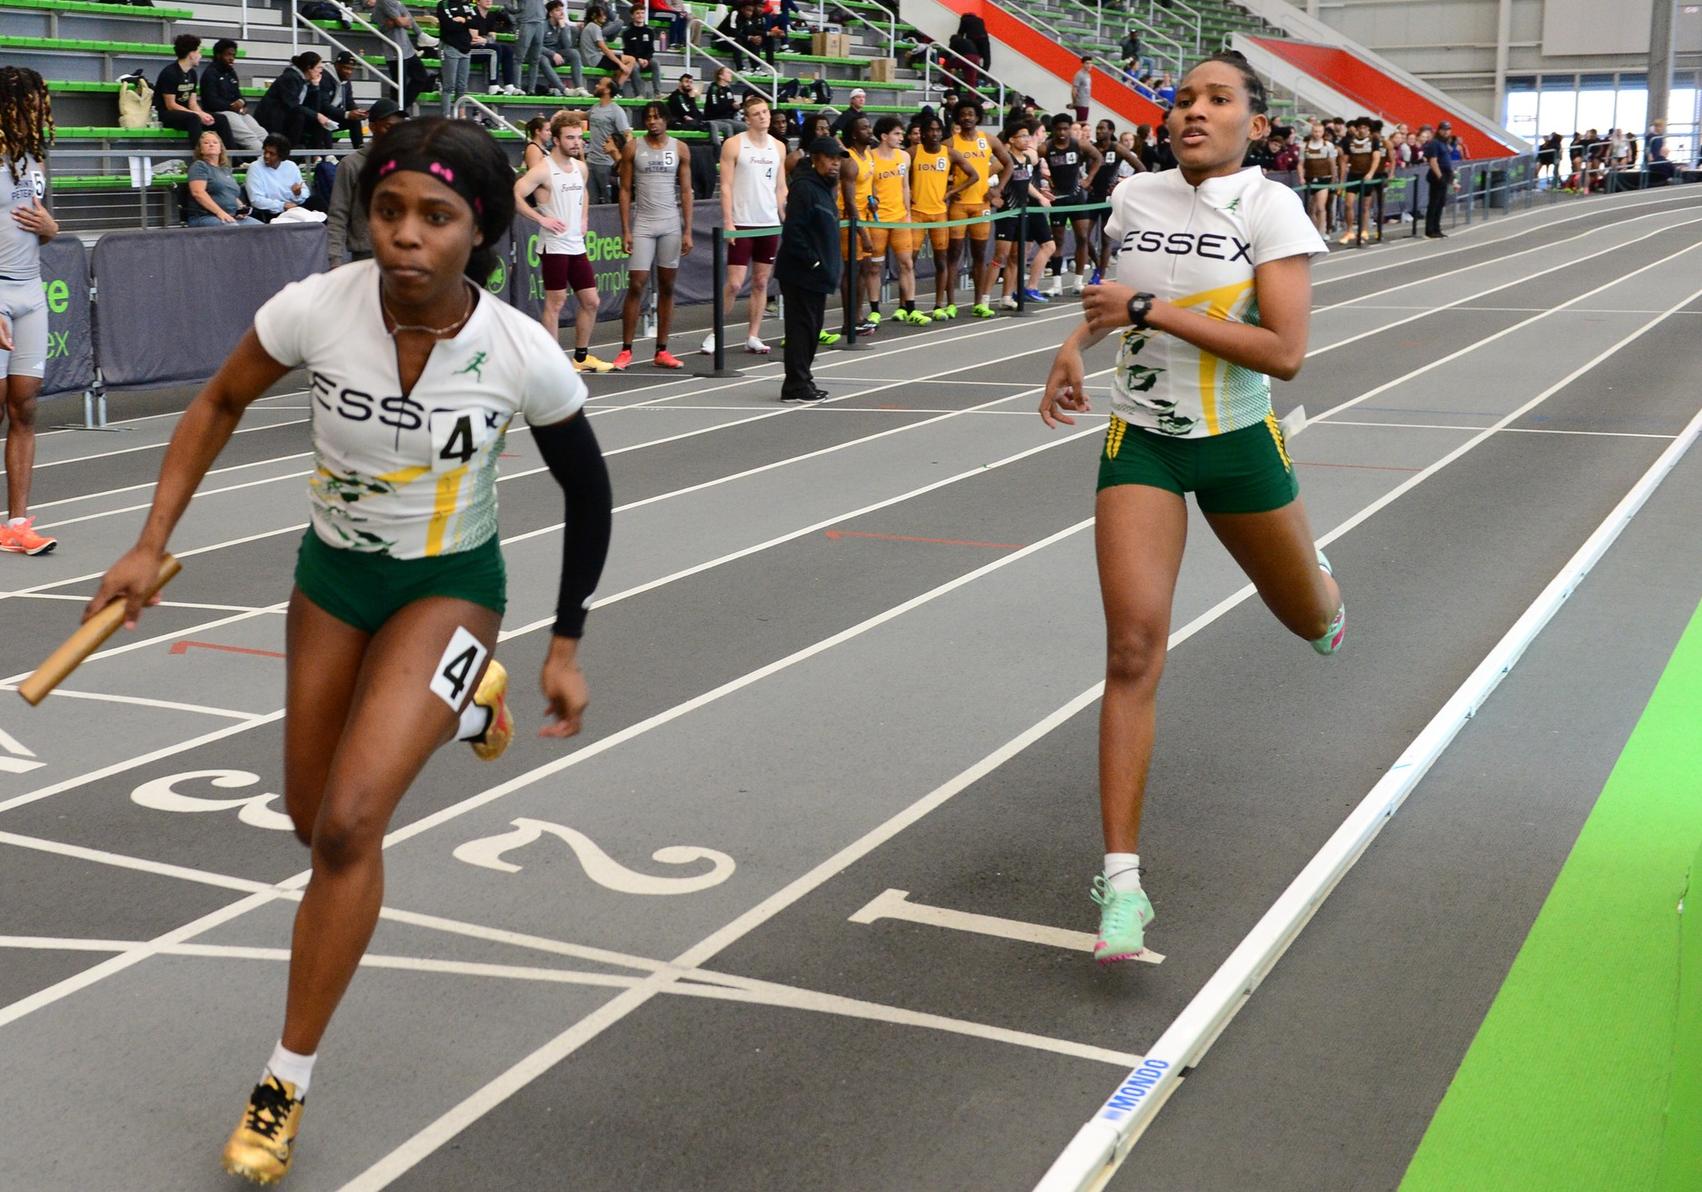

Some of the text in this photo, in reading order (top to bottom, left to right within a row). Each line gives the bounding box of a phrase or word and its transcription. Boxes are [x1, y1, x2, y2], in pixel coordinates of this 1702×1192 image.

[962, 151, 986, 159] ONA
[978, 139, 986, 149] 6
[665, 152, 673, 165] 5
[918, 163, 944, 172] ION
[937, 158, 946, 169] 6
[34, 172, 44, 196] 5
[765, 167, 772, 180] 4
[11, 189, 34, 200] PETER
[585, 230, 630, 262] Bree
[1120, 230, 1254, 265] ESSEX
[312, 372, 500, 431] ESSX
[439, 414, 478, 464] 4
[442, 645, 479, 700] 4
[451, 816, 737, 895] 2
[846, 888, 1167, 965] 1
[1107, 1058, 1169, 1113] MONDO
